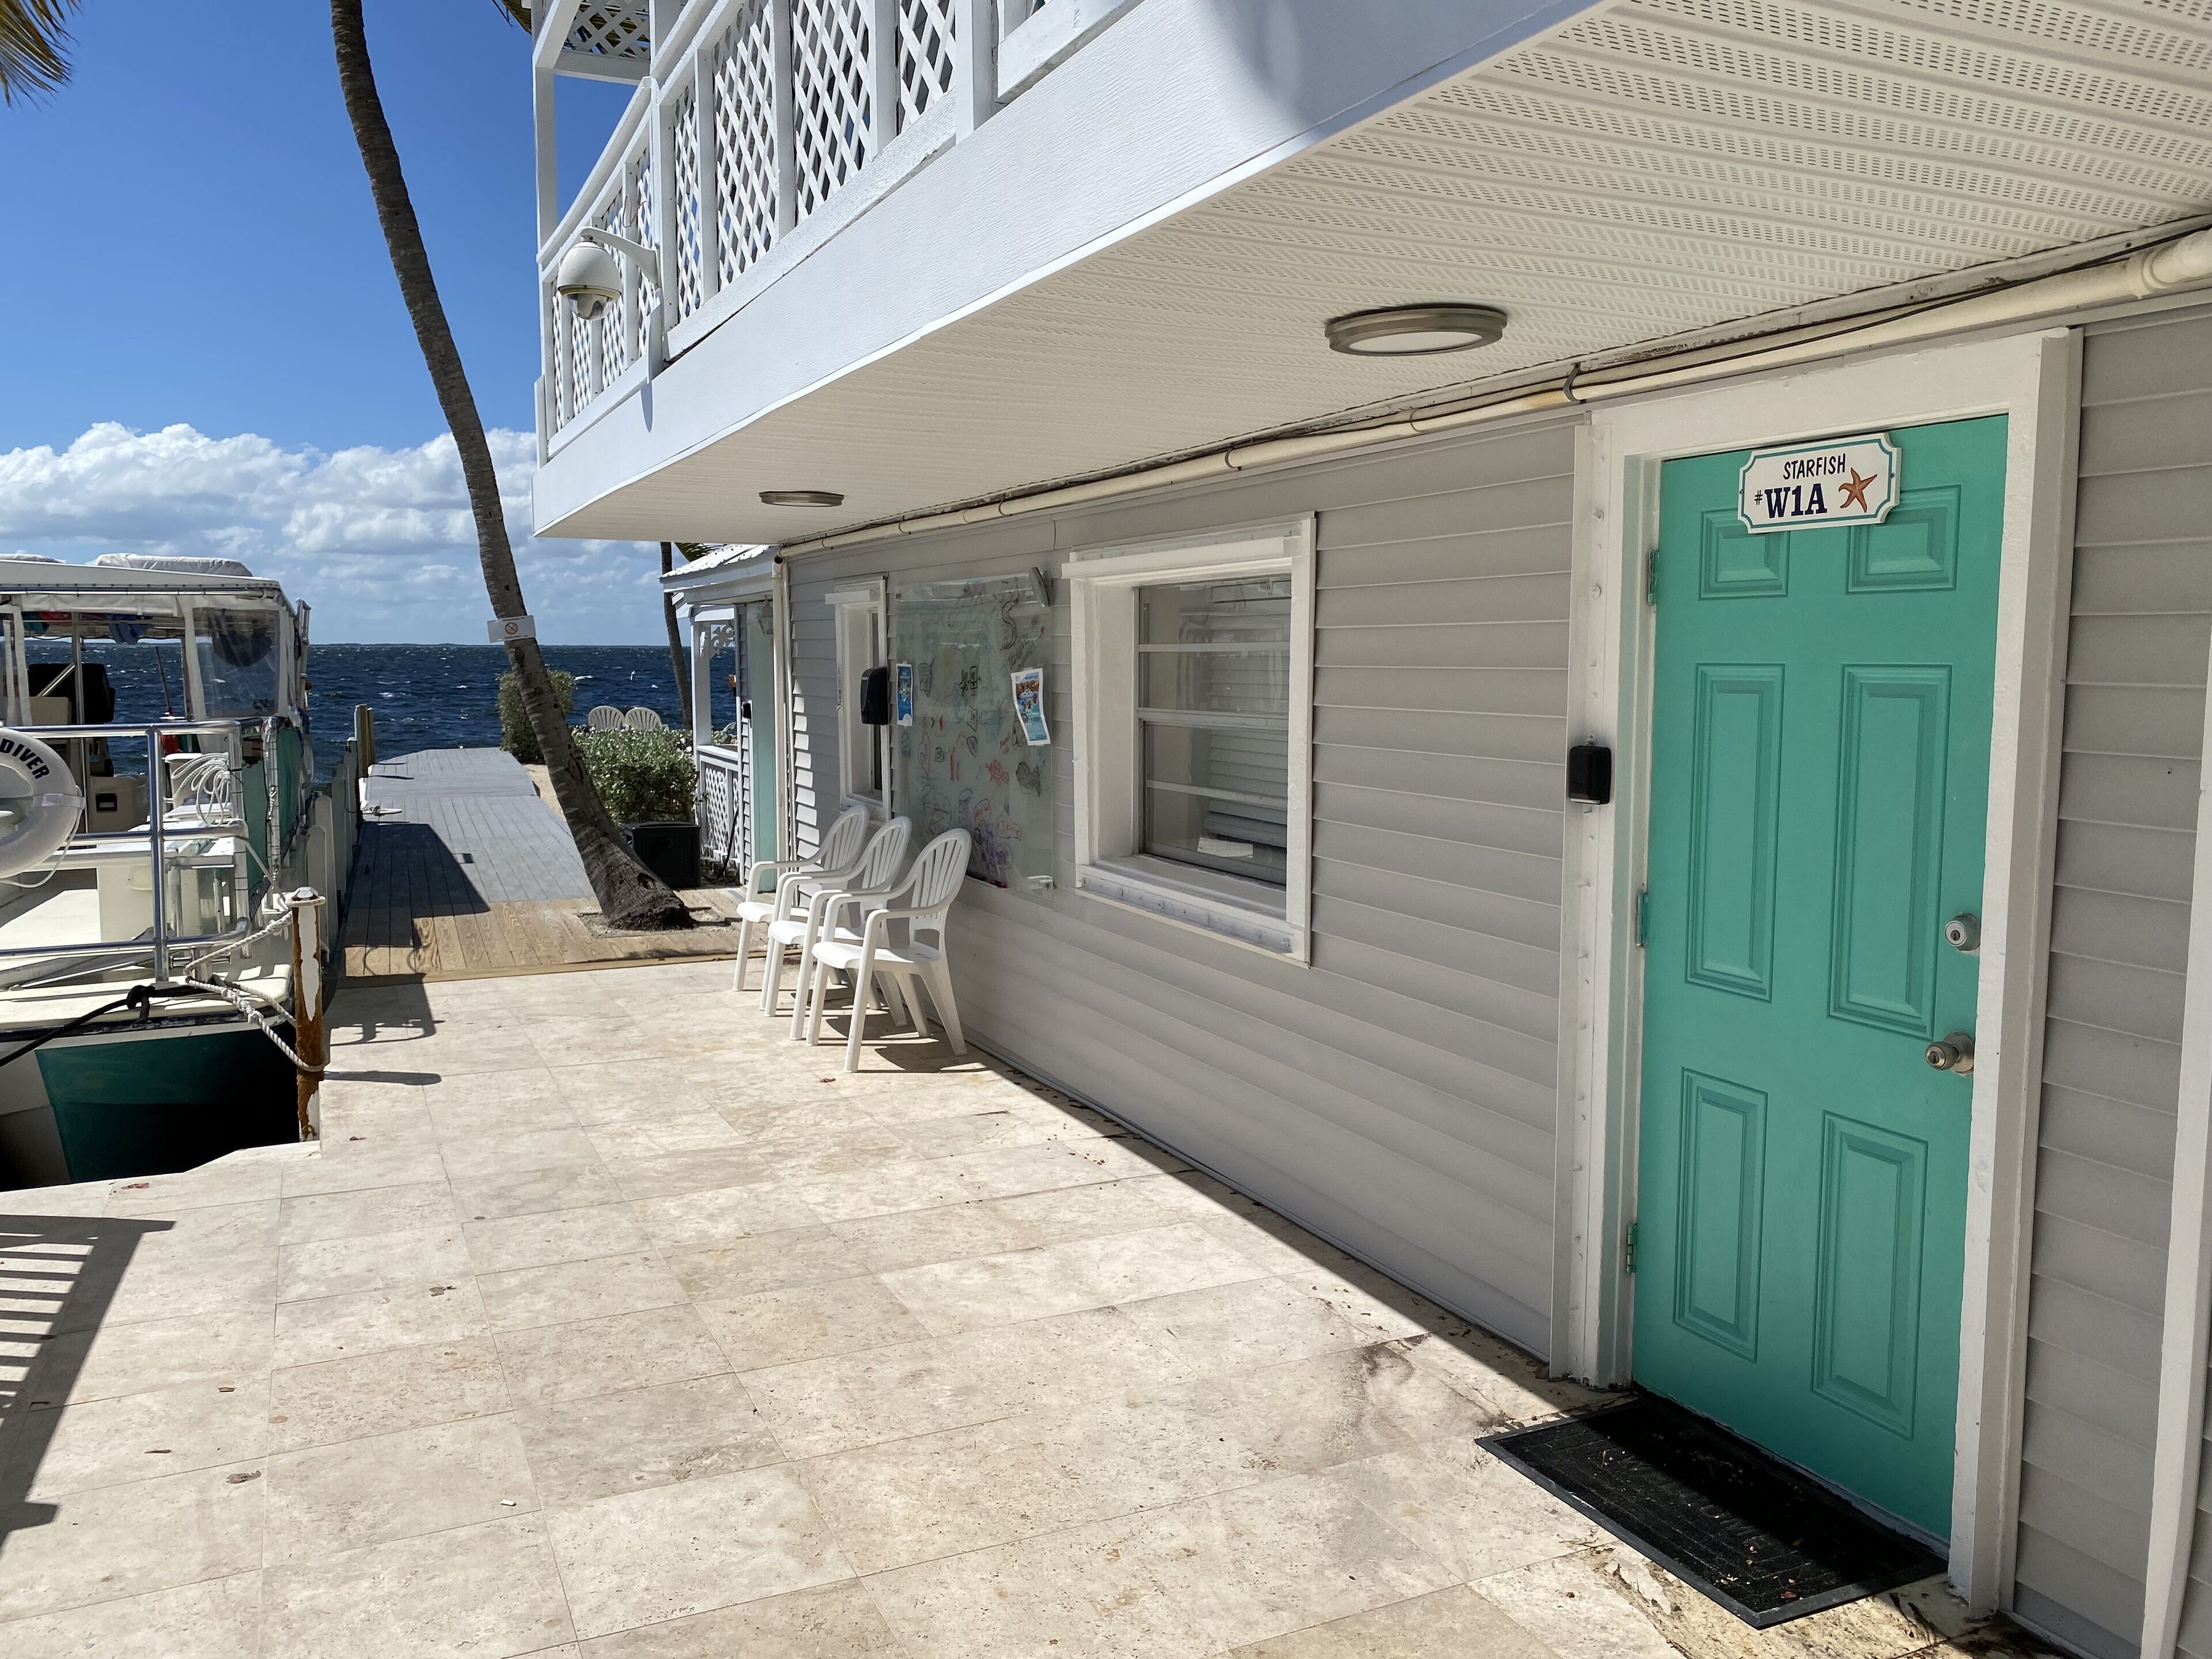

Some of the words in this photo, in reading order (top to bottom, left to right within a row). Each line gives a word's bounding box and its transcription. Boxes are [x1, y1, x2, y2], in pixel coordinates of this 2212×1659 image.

[1783, 453, 1846, 480] STARFISH
[1754, 483, 1828, 518] #W1A
[0, 738, 50, 779] DIVER
